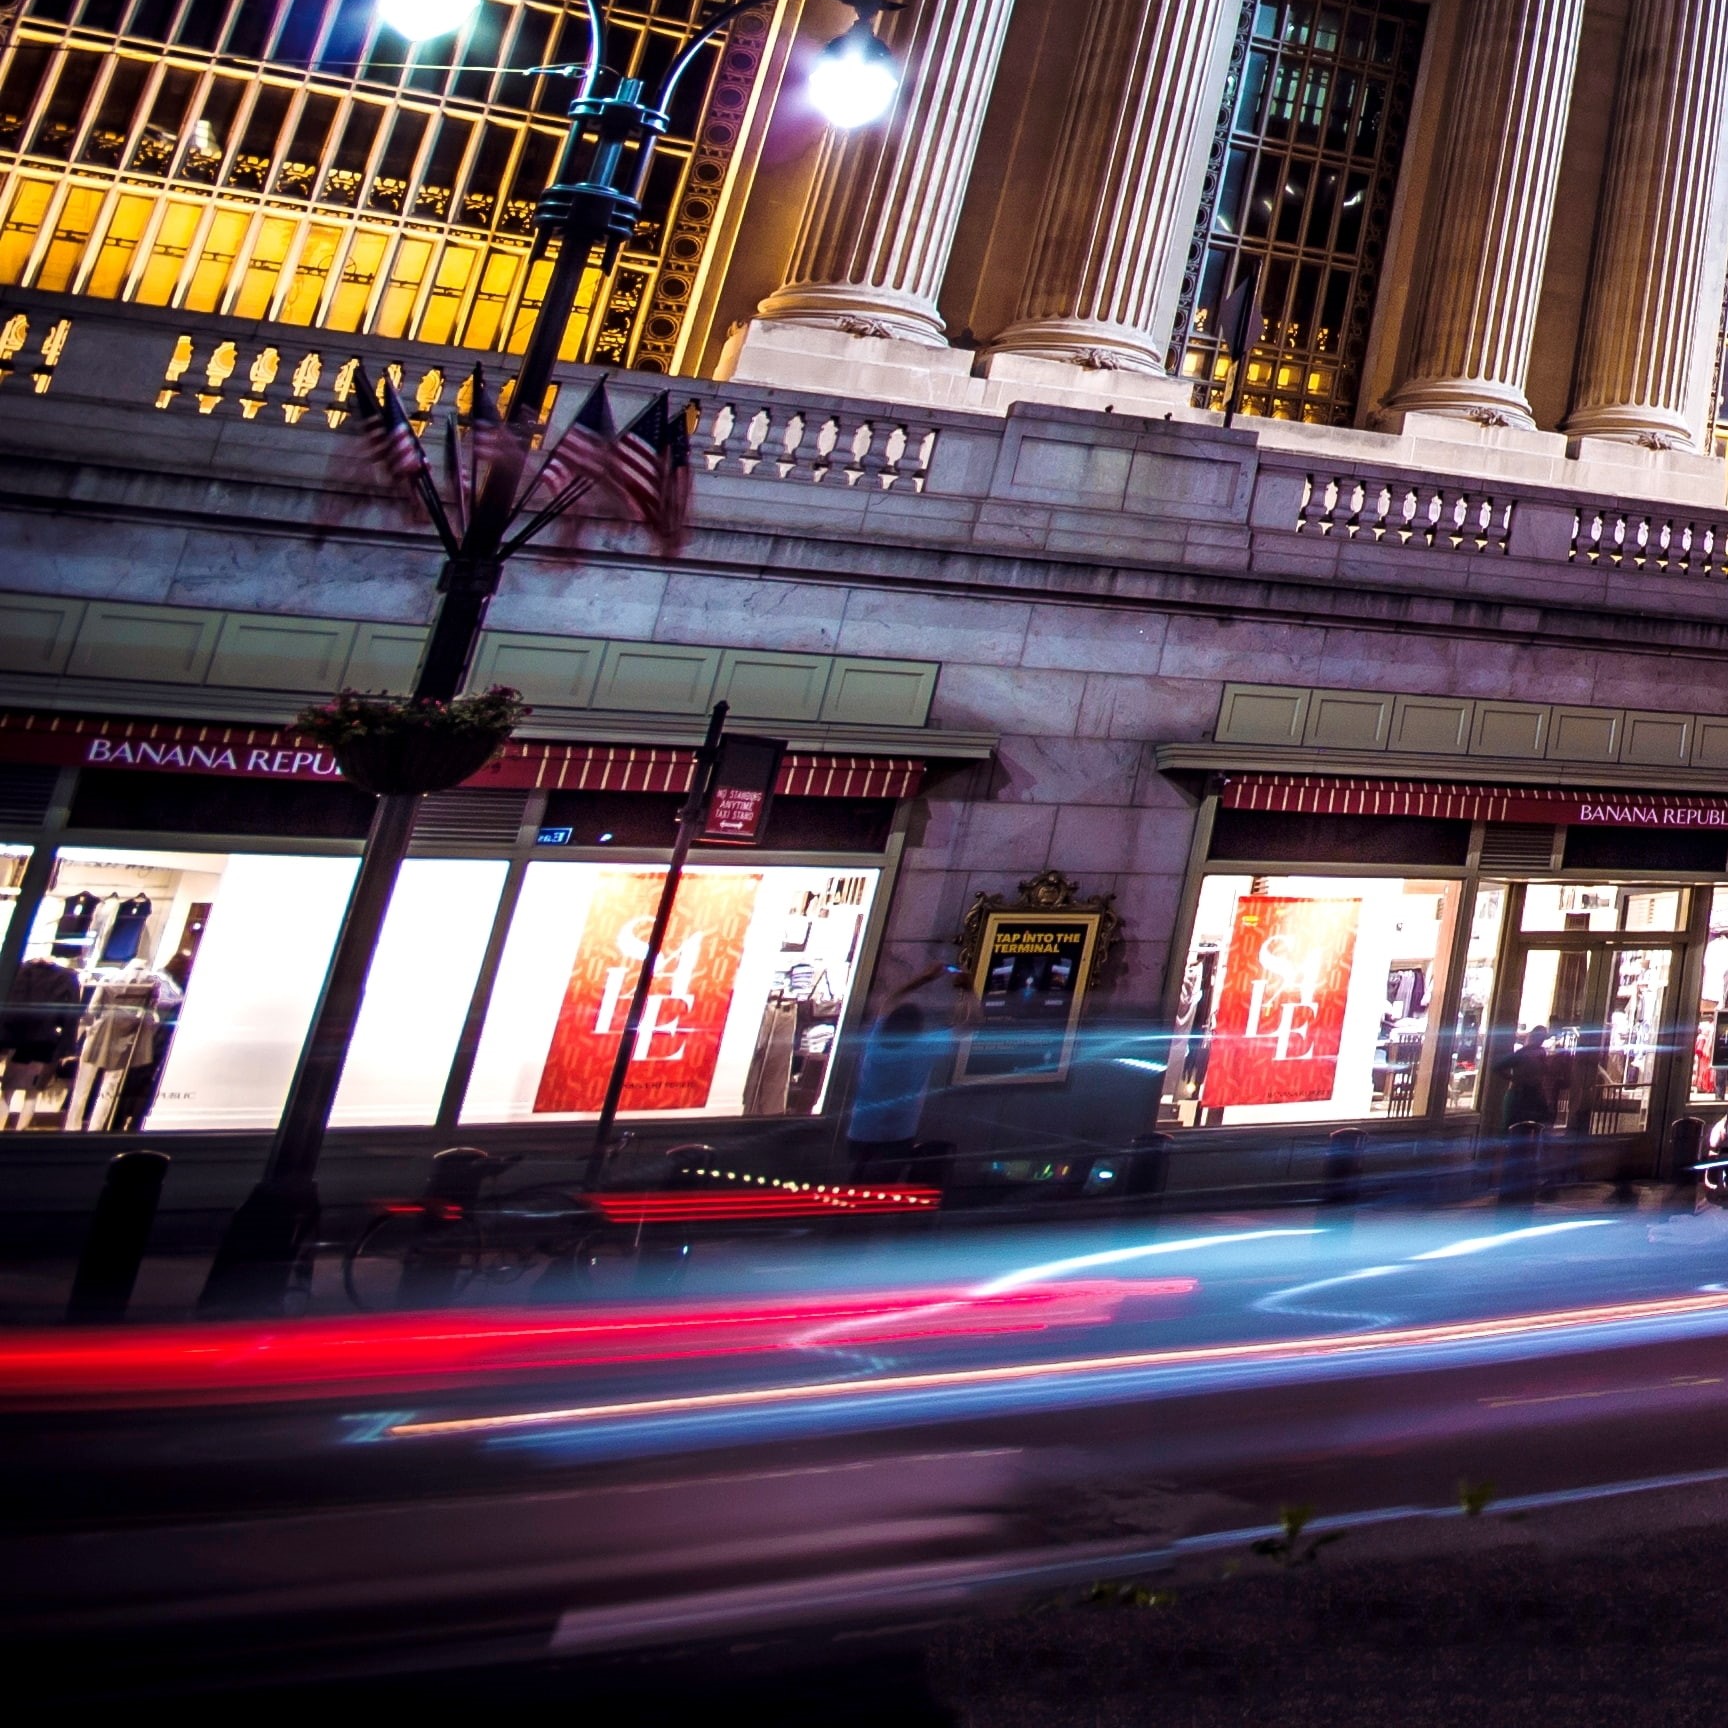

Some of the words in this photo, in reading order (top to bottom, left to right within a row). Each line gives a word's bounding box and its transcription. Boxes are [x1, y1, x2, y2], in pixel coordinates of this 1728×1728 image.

[87, 738, 238, 771] BANANA
[1580, 803, 1659, 824] BANANA
[995, 933, 1021, 943] TAP
[1022, 932, 1054, 943] INTO
[1057, 933, 1081, 943] THE
[993, 943, 1060, 953] TERMINAL
